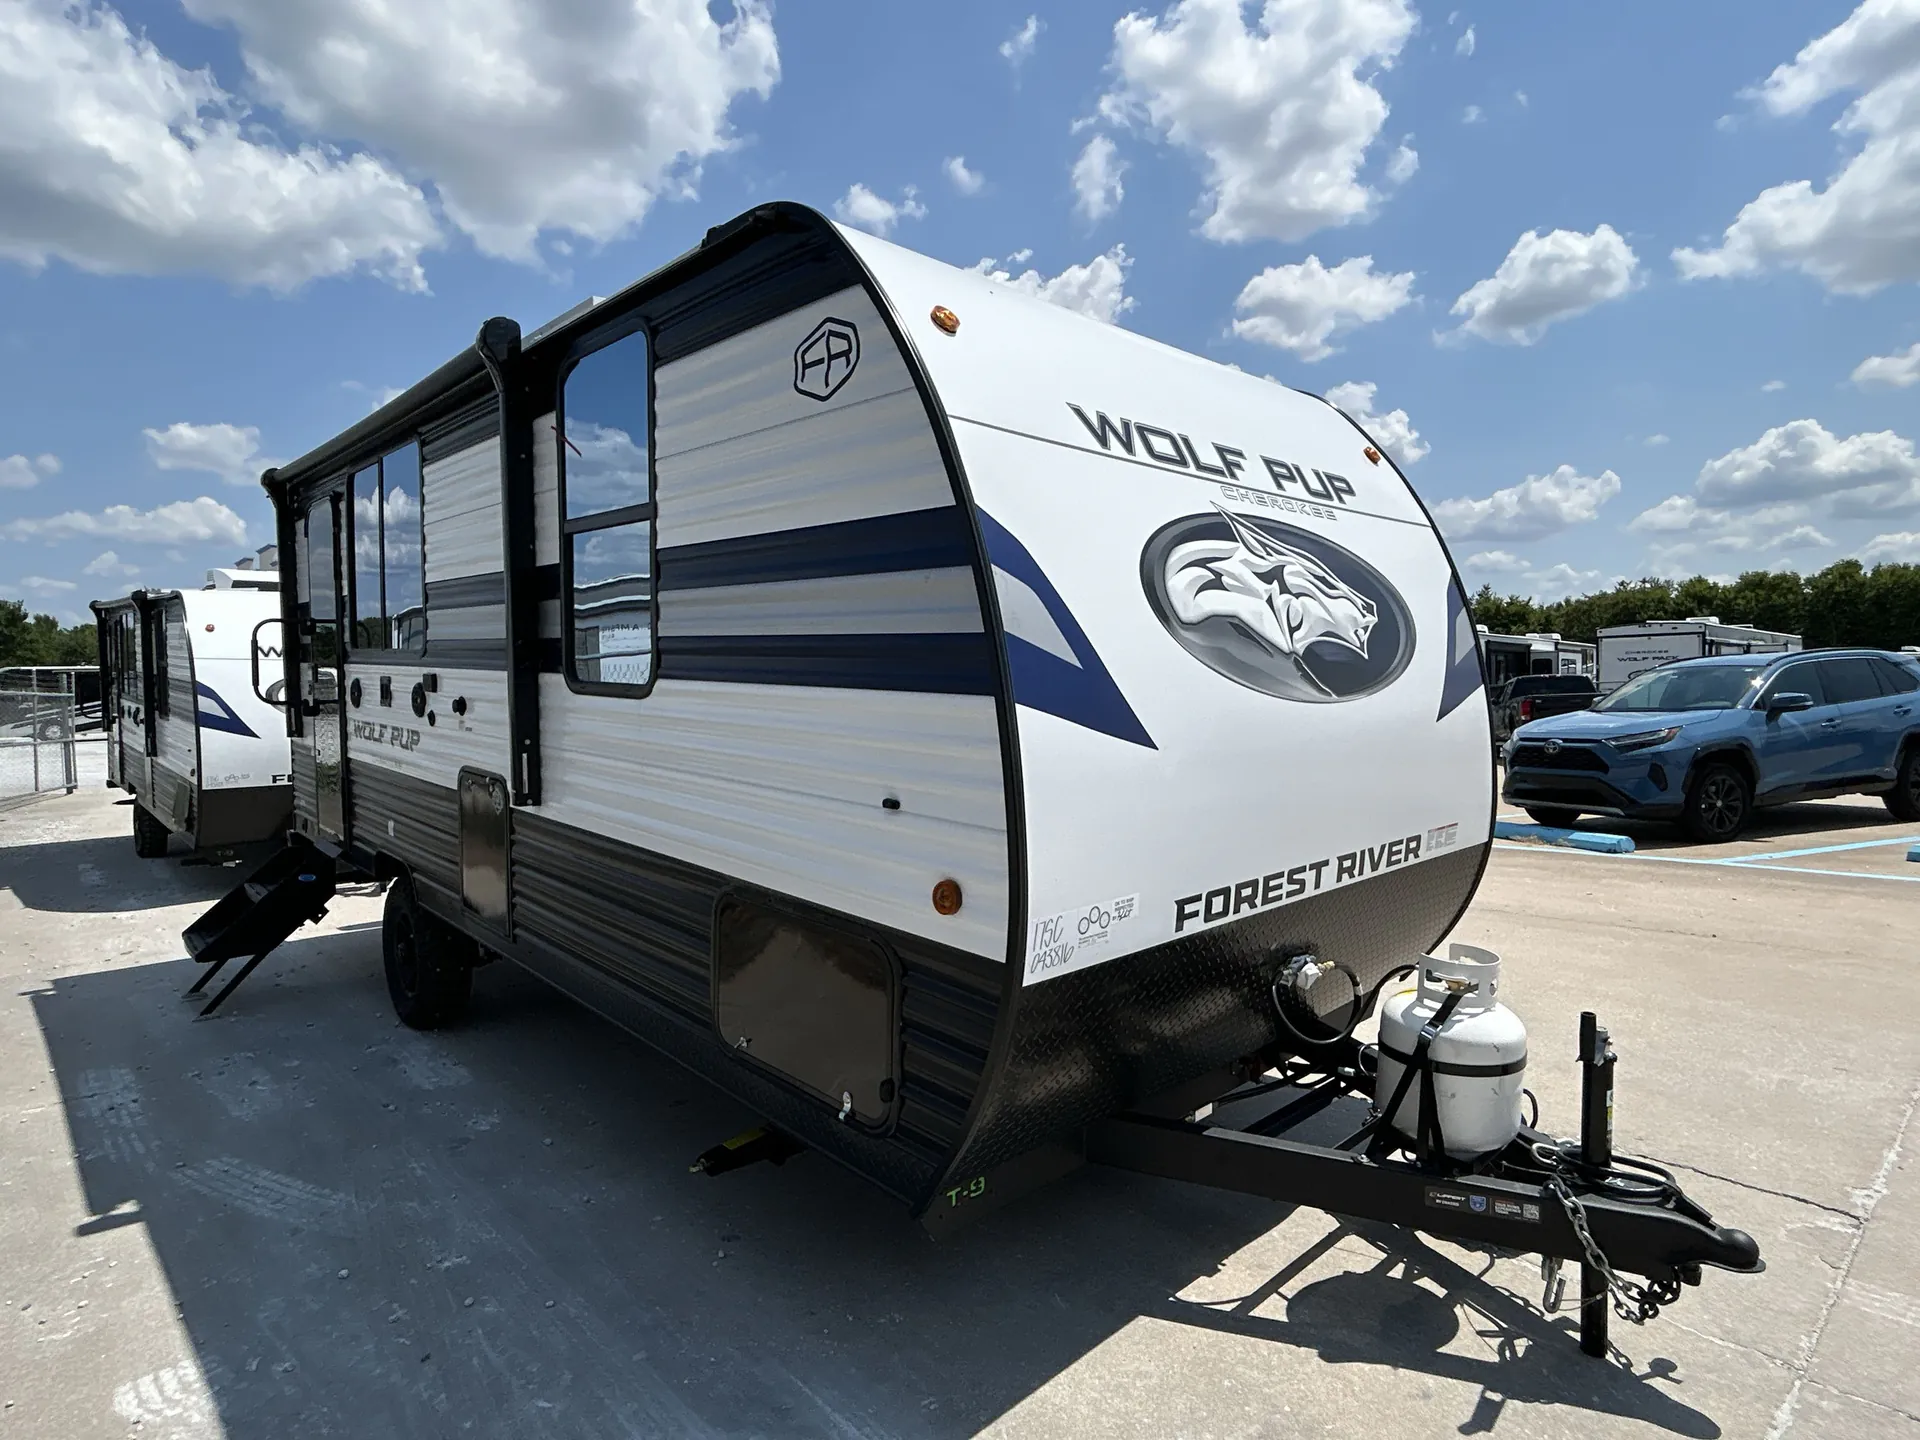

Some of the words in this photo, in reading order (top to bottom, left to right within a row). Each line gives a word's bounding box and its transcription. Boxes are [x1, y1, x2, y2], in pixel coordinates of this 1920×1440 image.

[1065, 401, 1247, 481] WOLF
[1259, 454, 1356, 504] PUP
[1220, 485, 1337, 521] CHEROKEE
[353, 720, 388, 744] WOLF
[390, 725, 421, 752] PUP
[1174, 858, 1330, 933] FOREST
[1336, 833, 1422, 883] RIVER
